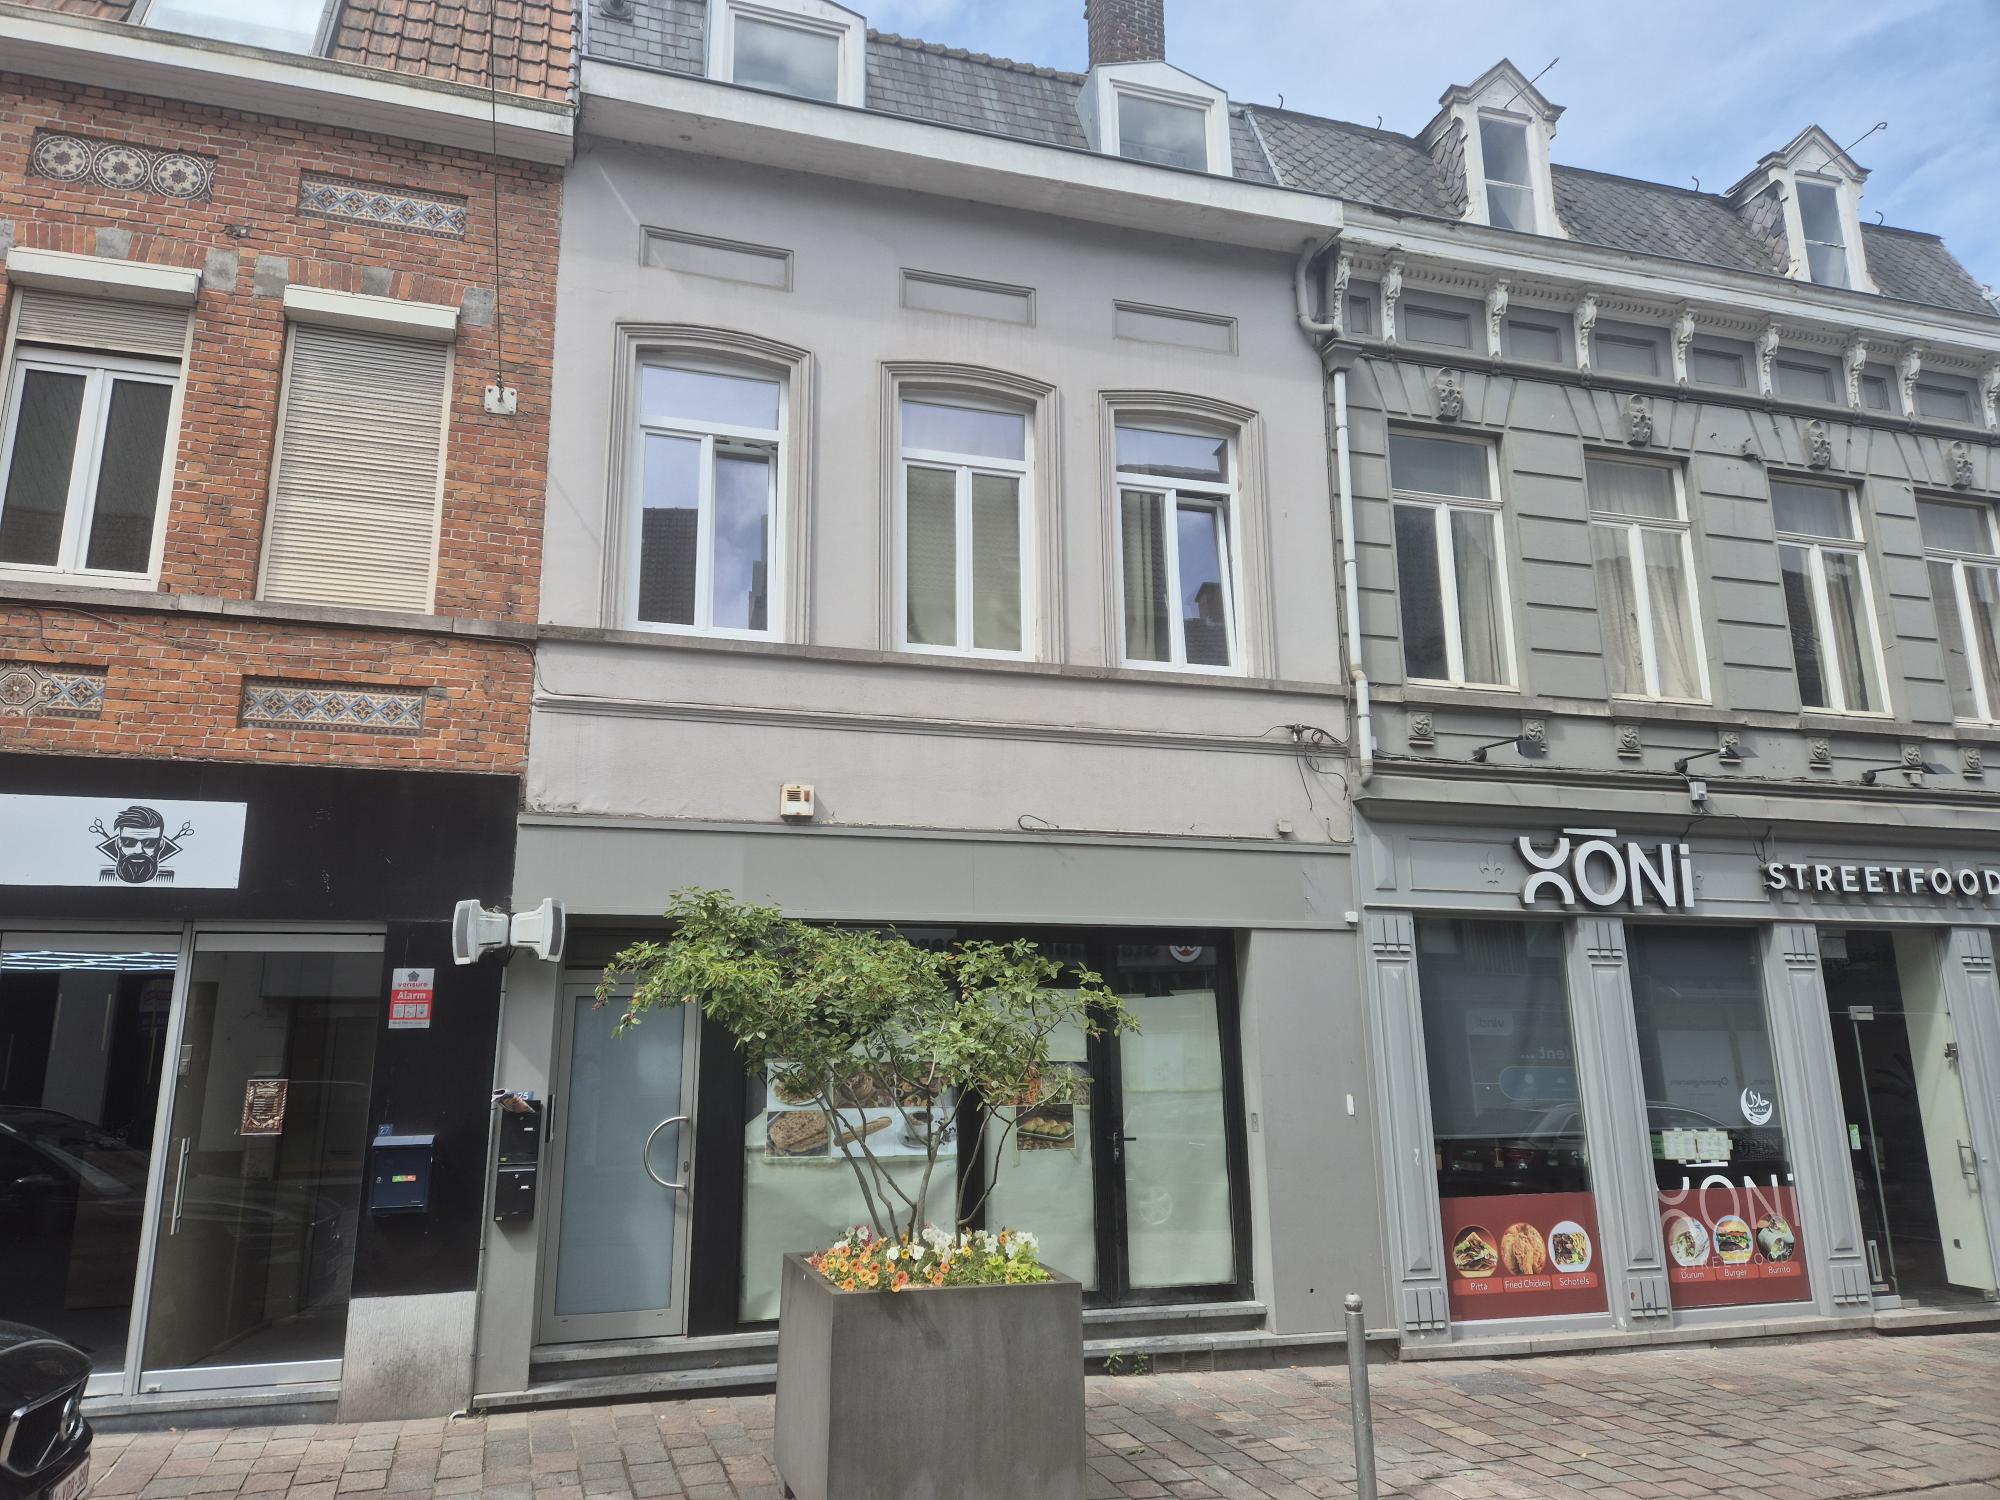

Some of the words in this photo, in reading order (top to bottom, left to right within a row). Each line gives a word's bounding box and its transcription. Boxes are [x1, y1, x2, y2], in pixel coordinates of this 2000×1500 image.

[1768, 862, 2000, 896] STREETFOOD
[397, 991, 426, 1000] Alarm
[518, 1091, 529, 1100] 25
[1724, 1268, 1747, 1278] Burger
[1768, 1266, 1791, 1274] Burrito
[1505, 1280, 1523, 1289] Fried
[1523, 1279, 1551, 1288] Chicken
[1559, 1277, 1590, 1286] Schotels
[1470, 1282, 1488, 1291] Pitta
